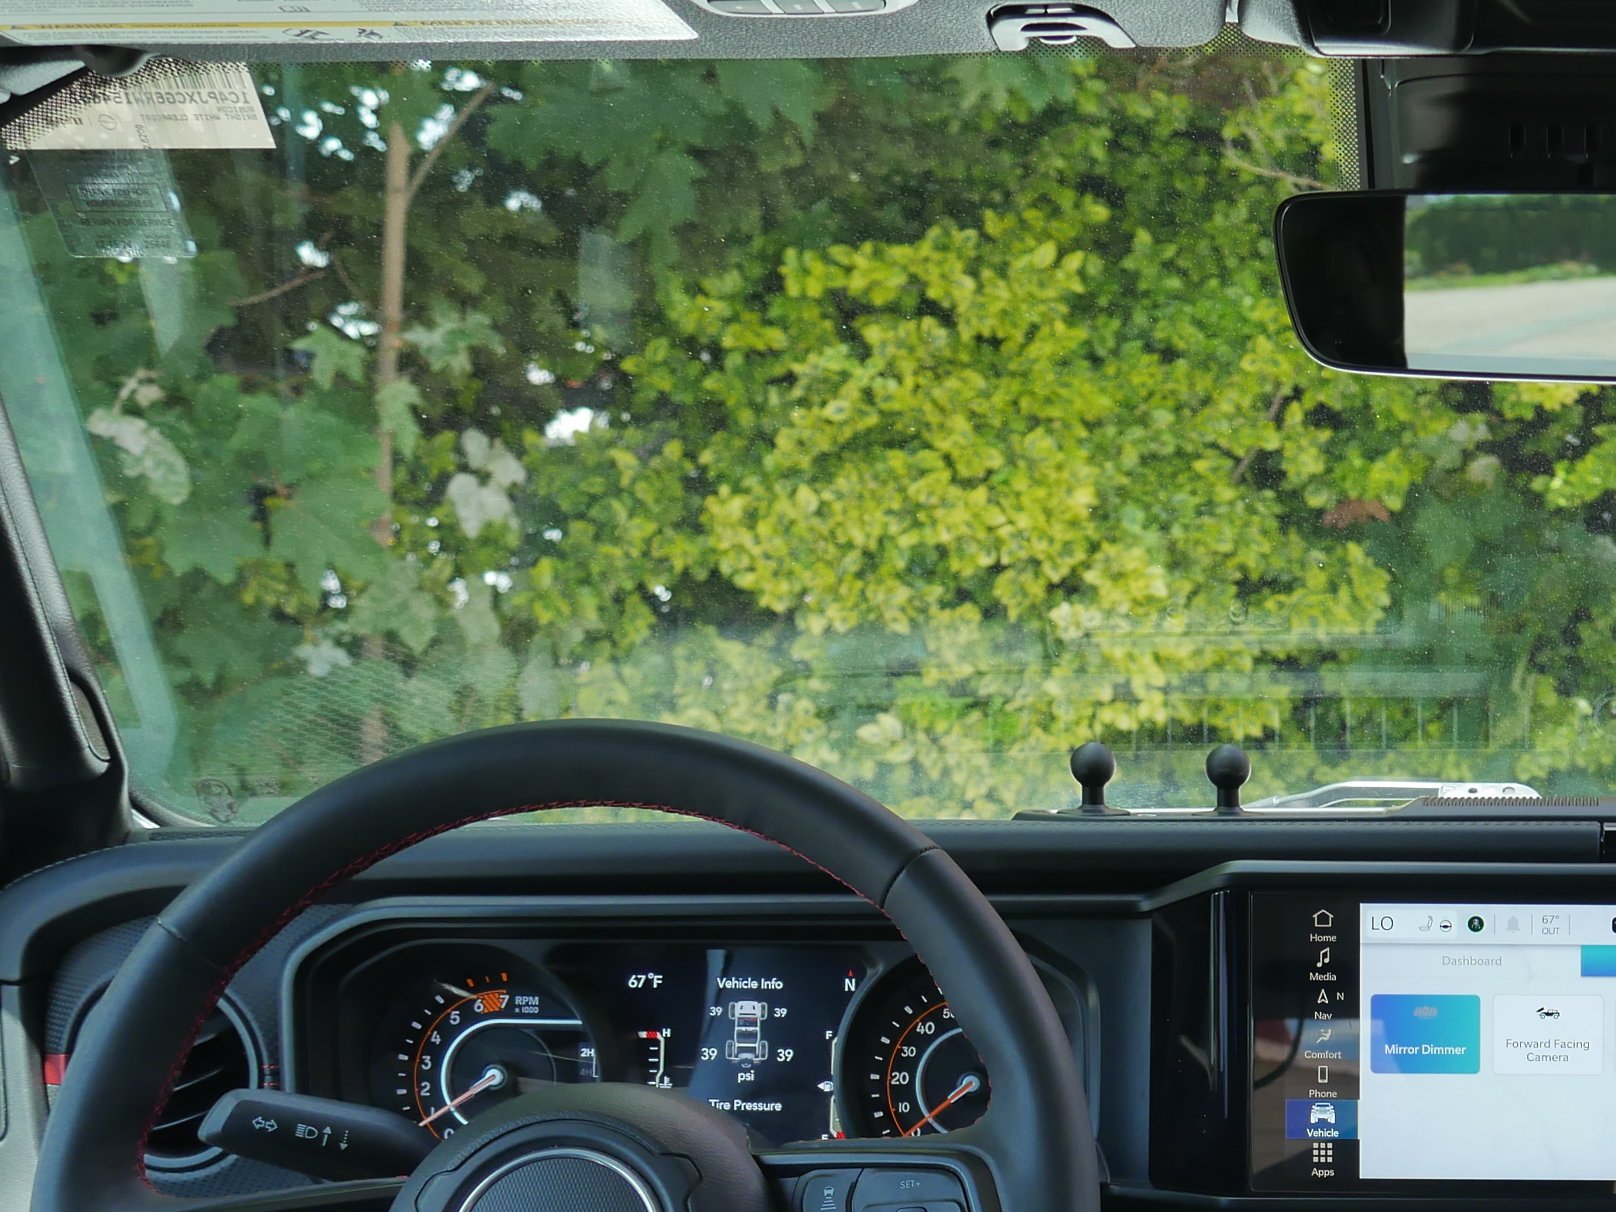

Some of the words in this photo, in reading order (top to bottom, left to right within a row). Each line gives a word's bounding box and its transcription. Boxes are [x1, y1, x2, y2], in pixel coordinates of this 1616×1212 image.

[1371, 915, 1394, 931] LO
[1542, 915, 1560, 925] 67°
[1541, 927, 1560, 935] OUT
[1309, 933, 1337, 942] Home
[1441, 955, 1502, 966] Dashboard
[628, 973, 663, 988] 67°F
[1309, 972, 1337, 982] Media
[717, 977, 758, 989] Vehicle
[761, 978, 784, 989] Info
[844, 978, 856, 991] N
[499, 995, 509, 1009] 7
[515, 996, 539, 1005] RPM
[1336, 992, 1345, 1001] N
[473, 998, 484, 1013] 6
[521, 1006, 539, 1014] 1000
[709, 1006, 723, 1016] 39
[449, 1010, 461, 1025] 5
[774, 1008, 787, 1018] 39
[1314, 1011, 1333, 1020] Nav
[662, 1028, 671, 1038] H
[916, 1021, 935, 1035] 40
[430, 1030, 442, 1045] 4
[825, 1031, 833, 1040] F
[1384, 1044, 1420, 1055] Mirror
[1421, 1044, 1466, 1055] Dimmer
[1505, 1039, 1551, 1049] Forward
[1553, 1039, 1590, 1051] Facing
[580, 1048, 594, 1057] 2H
[700, 1048, 718, 1060] 39
[776, 1049, 794, 1062] 39
[901, 1046, 917, 1057] 30
[1304, 1050, 1342, 1060] Comfort
[422, 1055, 432, 1070] 3
[1526, 1053, 1569, 1063] Camera
[737, 1070, 756, 1083] psi
[890, 1072, 909, 1085] 20
[420, 1081, 431, 1096] 2
[1309, 1089, 1338, 1098] Phone
[709, 1099, 731, 1110] Tire
[734, 1100, 783, 1111] Pressure
[898, 1102, 910, 1113] 10
[1307, 1128, 1339, 1138] Vehicle
[1311, 1168, 1335, 1178] Apps
[900, 1180, 921, 1189] SET+
